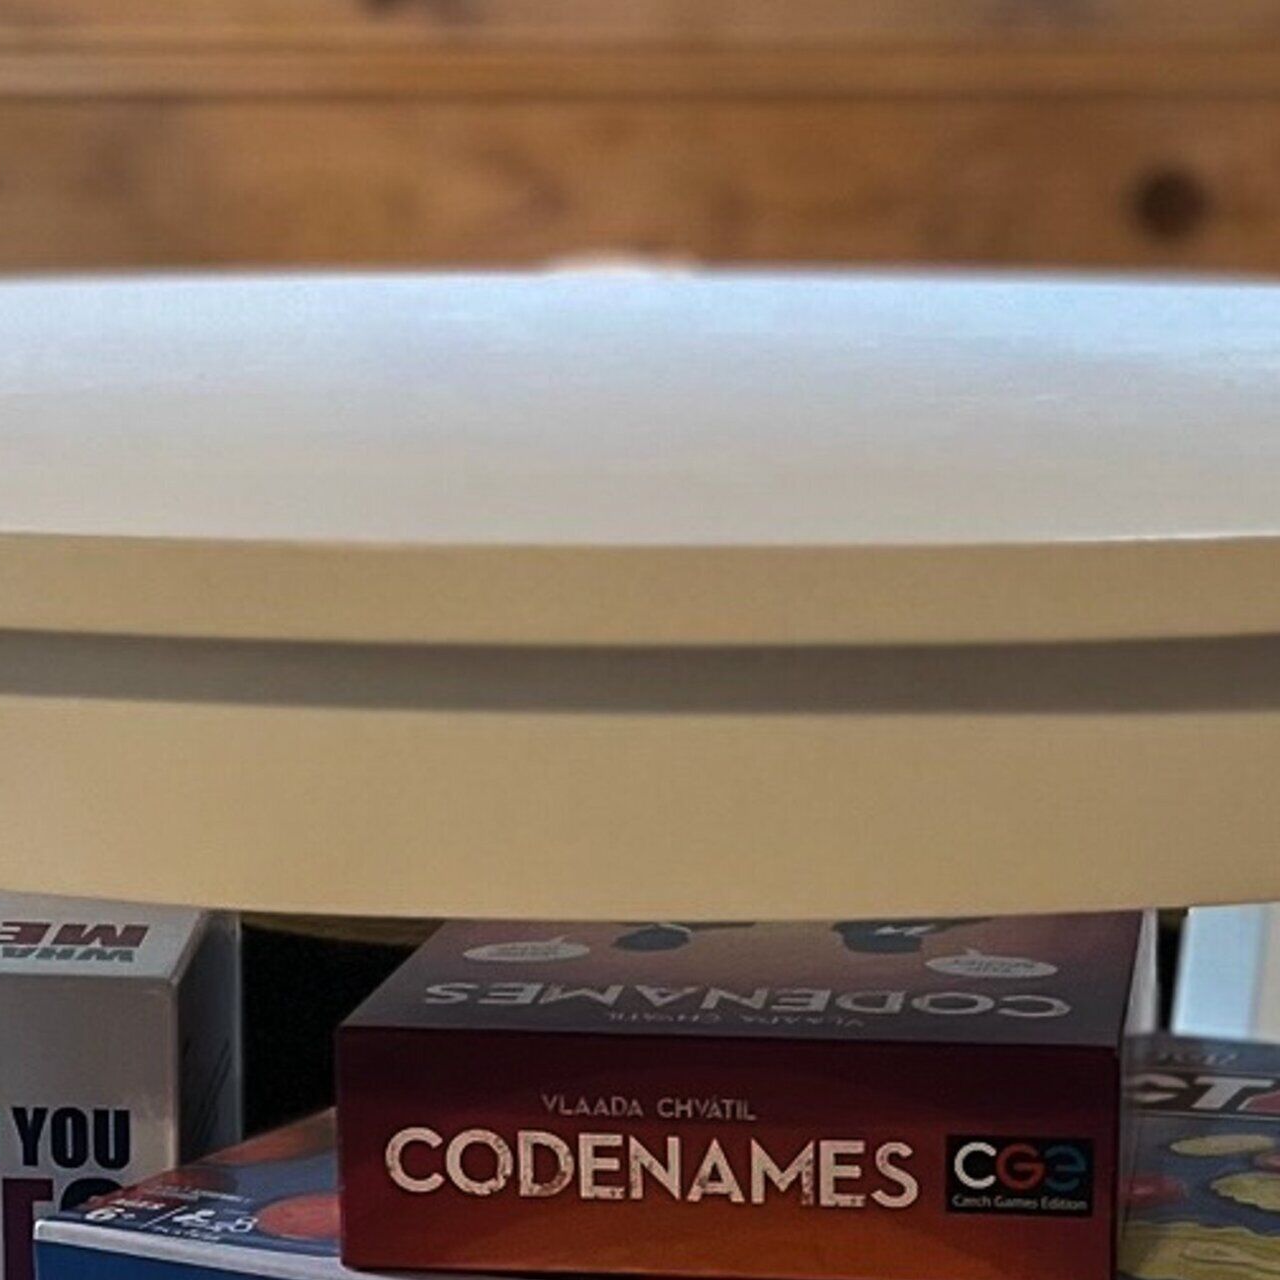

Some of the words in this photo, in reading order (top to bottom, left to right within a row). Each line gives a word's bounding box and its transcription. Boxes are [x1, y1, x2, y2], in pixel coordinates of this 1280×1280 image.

[424, 981, 1071, 1018] CODENAMES
[541, 1093, 645, 1118] VLAADA
[10, 1107, 131, 1170] YOU
[384, 1126, 920, 1209] CODENAMES
